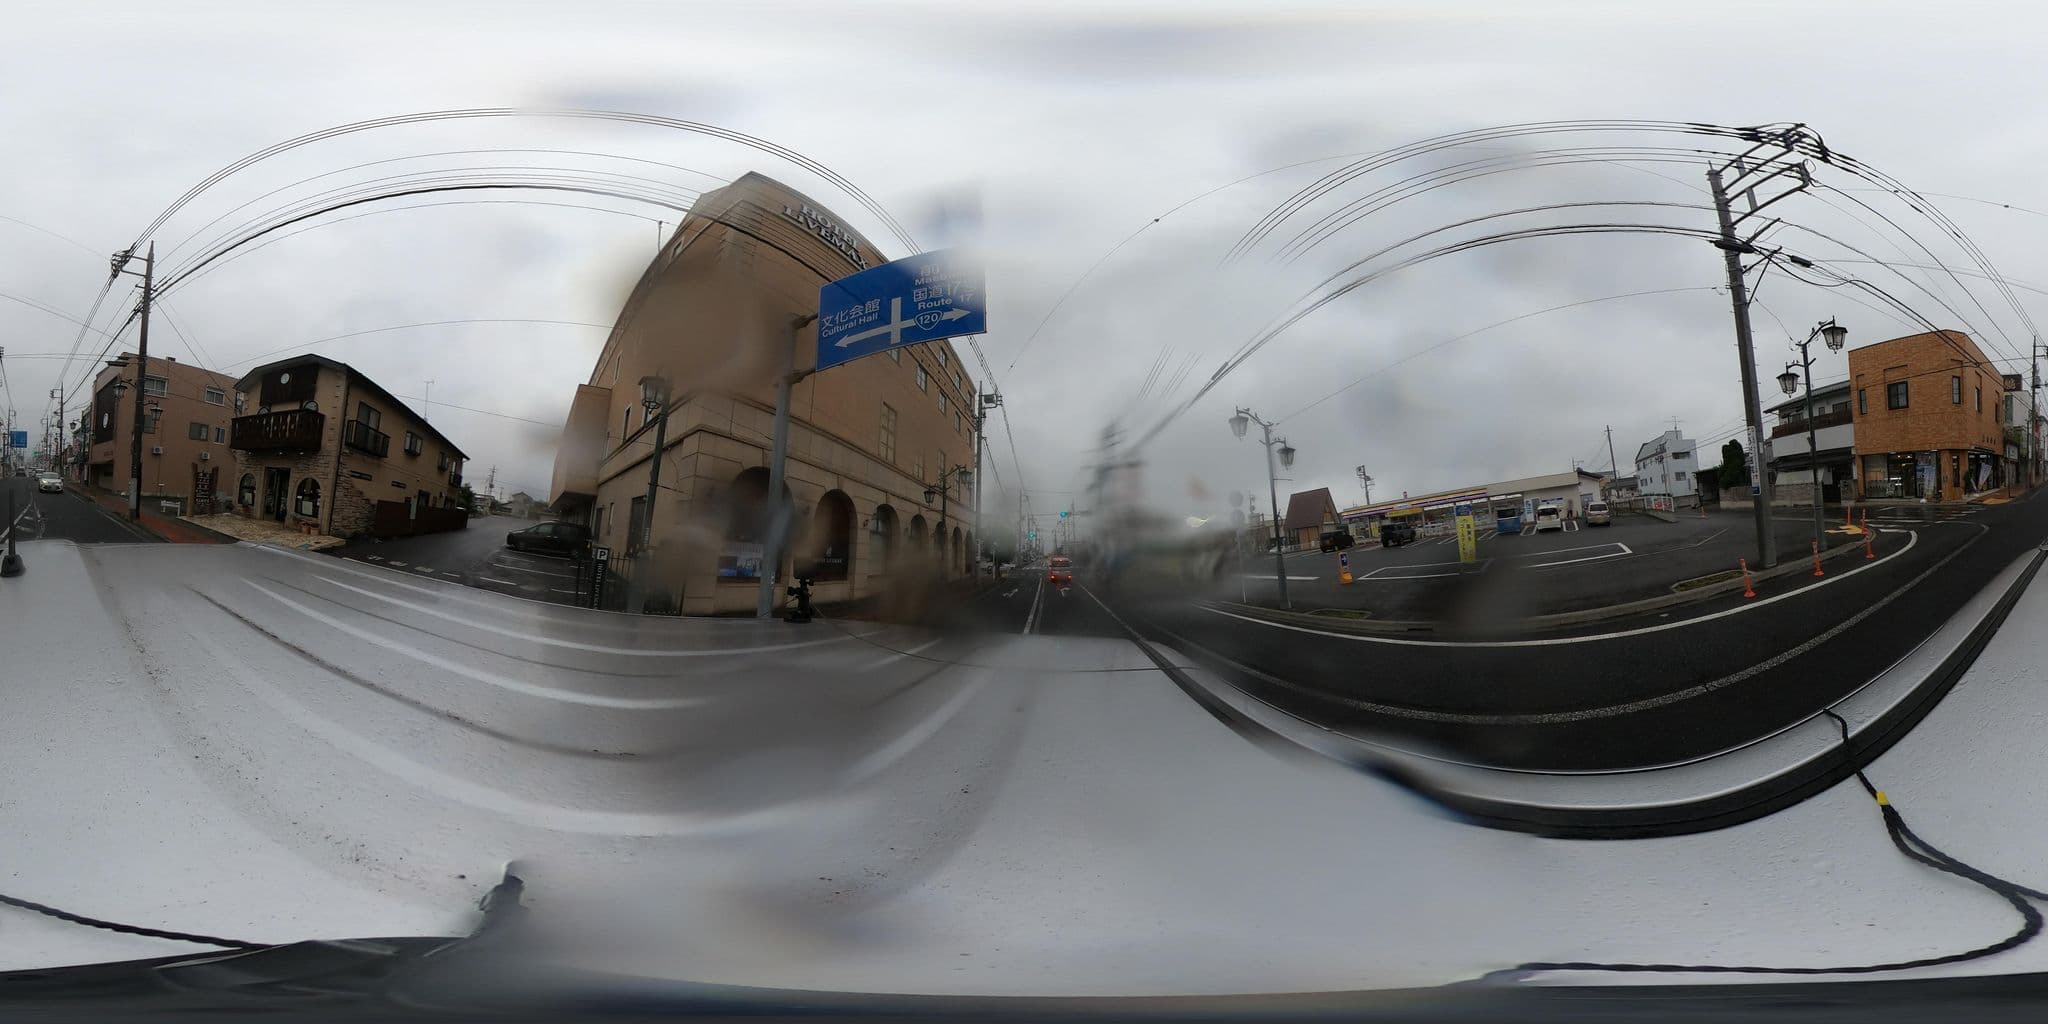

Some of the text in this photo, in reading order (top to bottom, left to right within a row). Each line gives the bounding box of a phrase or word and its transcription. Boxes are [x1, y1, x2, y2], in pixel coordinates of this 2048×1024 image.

[799, 204, 858, 249] HOTEL
[821, 298, 881, 331] 文化会館
[918, 294, 972, 311] Route 17
[822, 312, 878, 338] Cultural Hall
[920, 312, 939, 325] 120
